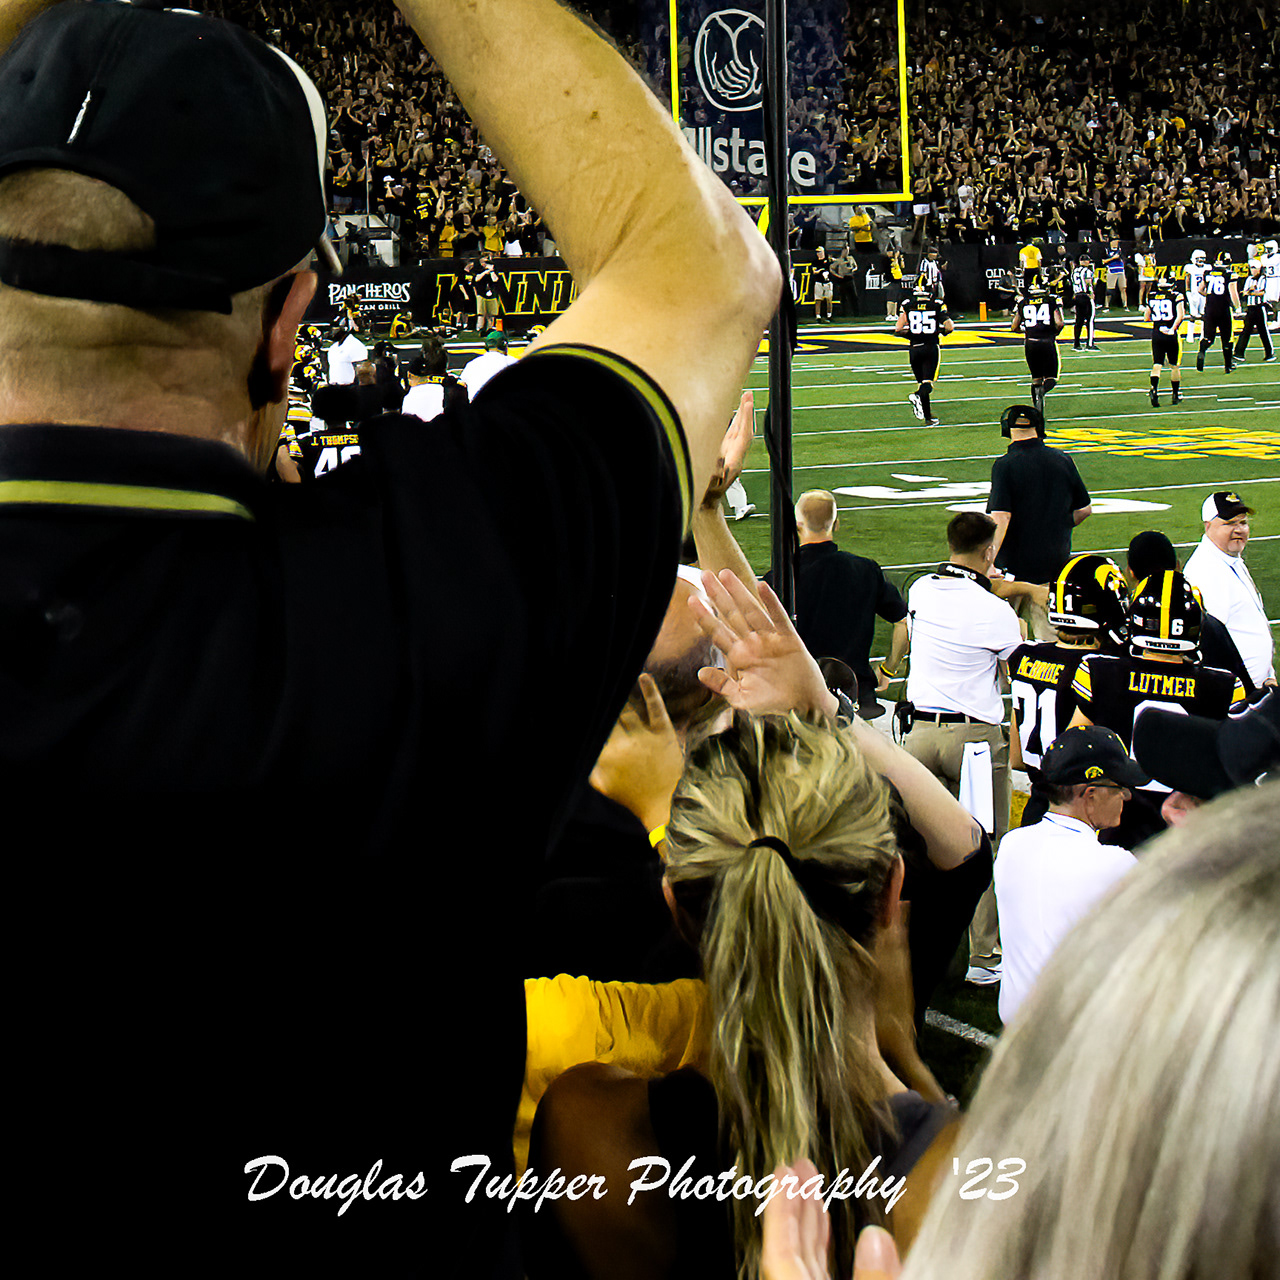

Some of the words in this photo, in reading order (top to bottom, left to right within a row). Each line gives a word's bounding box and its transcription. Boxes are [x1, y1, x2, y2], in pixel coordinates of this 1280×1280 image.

[328, 282, 411, 304] PANCHEROS
[1022, 304, 1051, 327] 94
[1149, 298, 1174, 321] 39
[908, 310, 937, 335] 85
[320, 434, 359, 446] THOMPS
[1171, 618, 1184, 636] 6
[1128, 671, 1195, 698] LUTMER
[1011, 679, 1057, 770] 21
